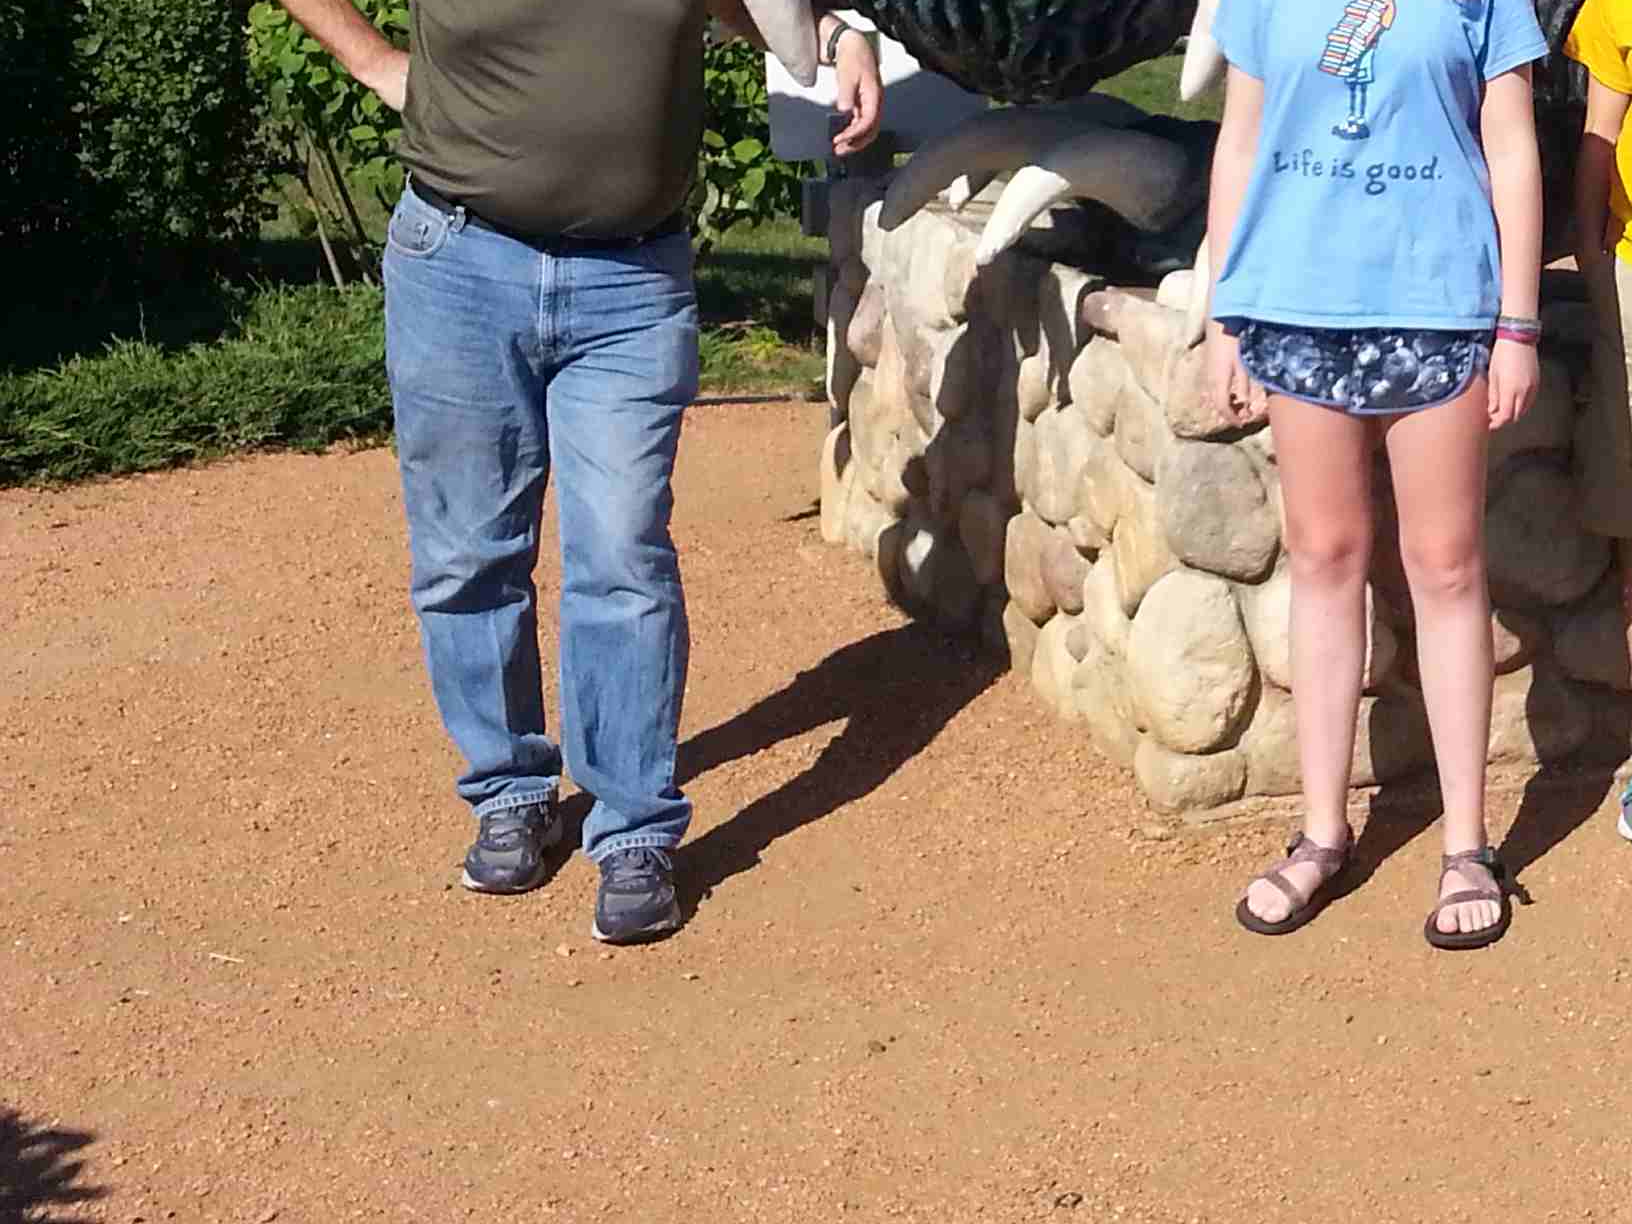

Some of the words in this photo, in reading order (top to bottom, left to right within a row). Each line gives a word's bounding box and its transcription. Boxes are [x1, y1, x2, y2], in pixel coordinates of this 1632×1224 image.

[1273, 149, 1323, 177] Life
[1331, 159, 1355, 178] is
[1365, 156, 1443, 195] good.
